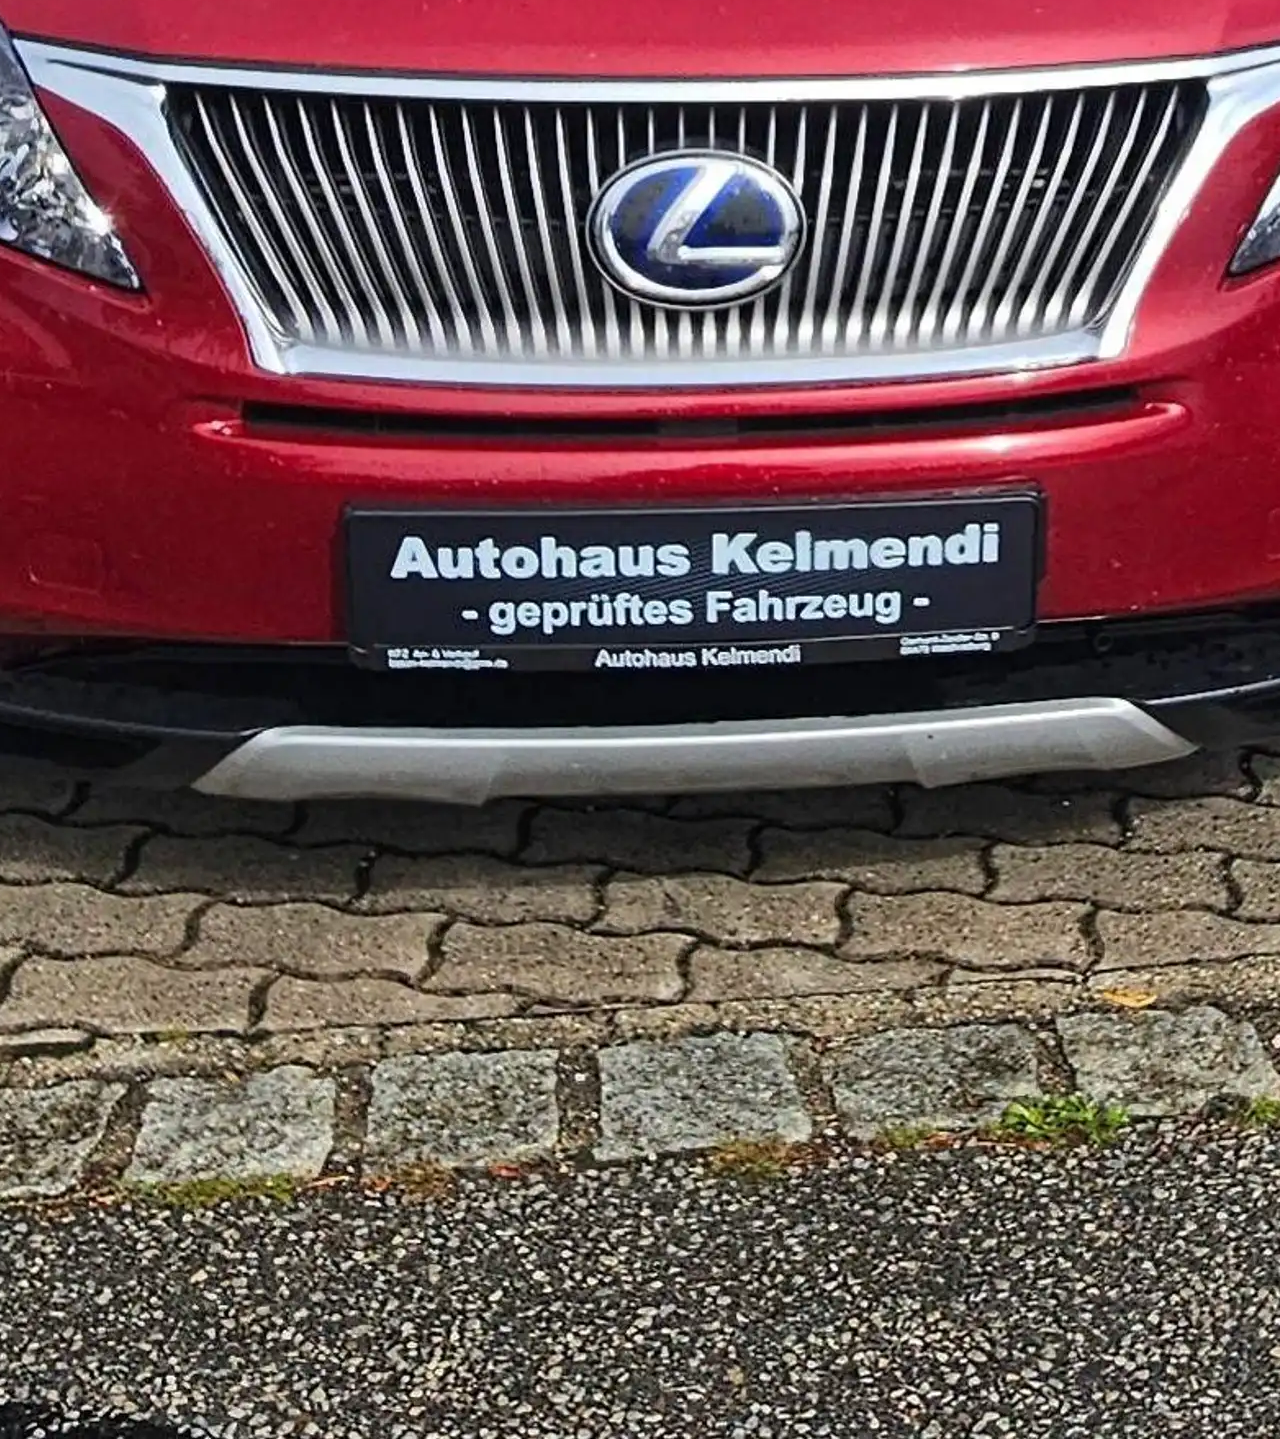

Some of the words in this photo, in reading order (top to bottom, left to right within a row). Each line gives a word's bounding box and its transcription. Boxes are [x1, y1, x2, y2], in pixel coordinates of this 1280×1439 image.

[390, 533, 691, 581] Autohaus
[710, 523, 1000, 577] Kelmendi
[488, 592, 694, 635] geprüftes
[705, 587, 902, 626] Fahrzeug
[594, 647, 697, 670] Autohaus
[700, 644, 802, 668] Kelmendi
